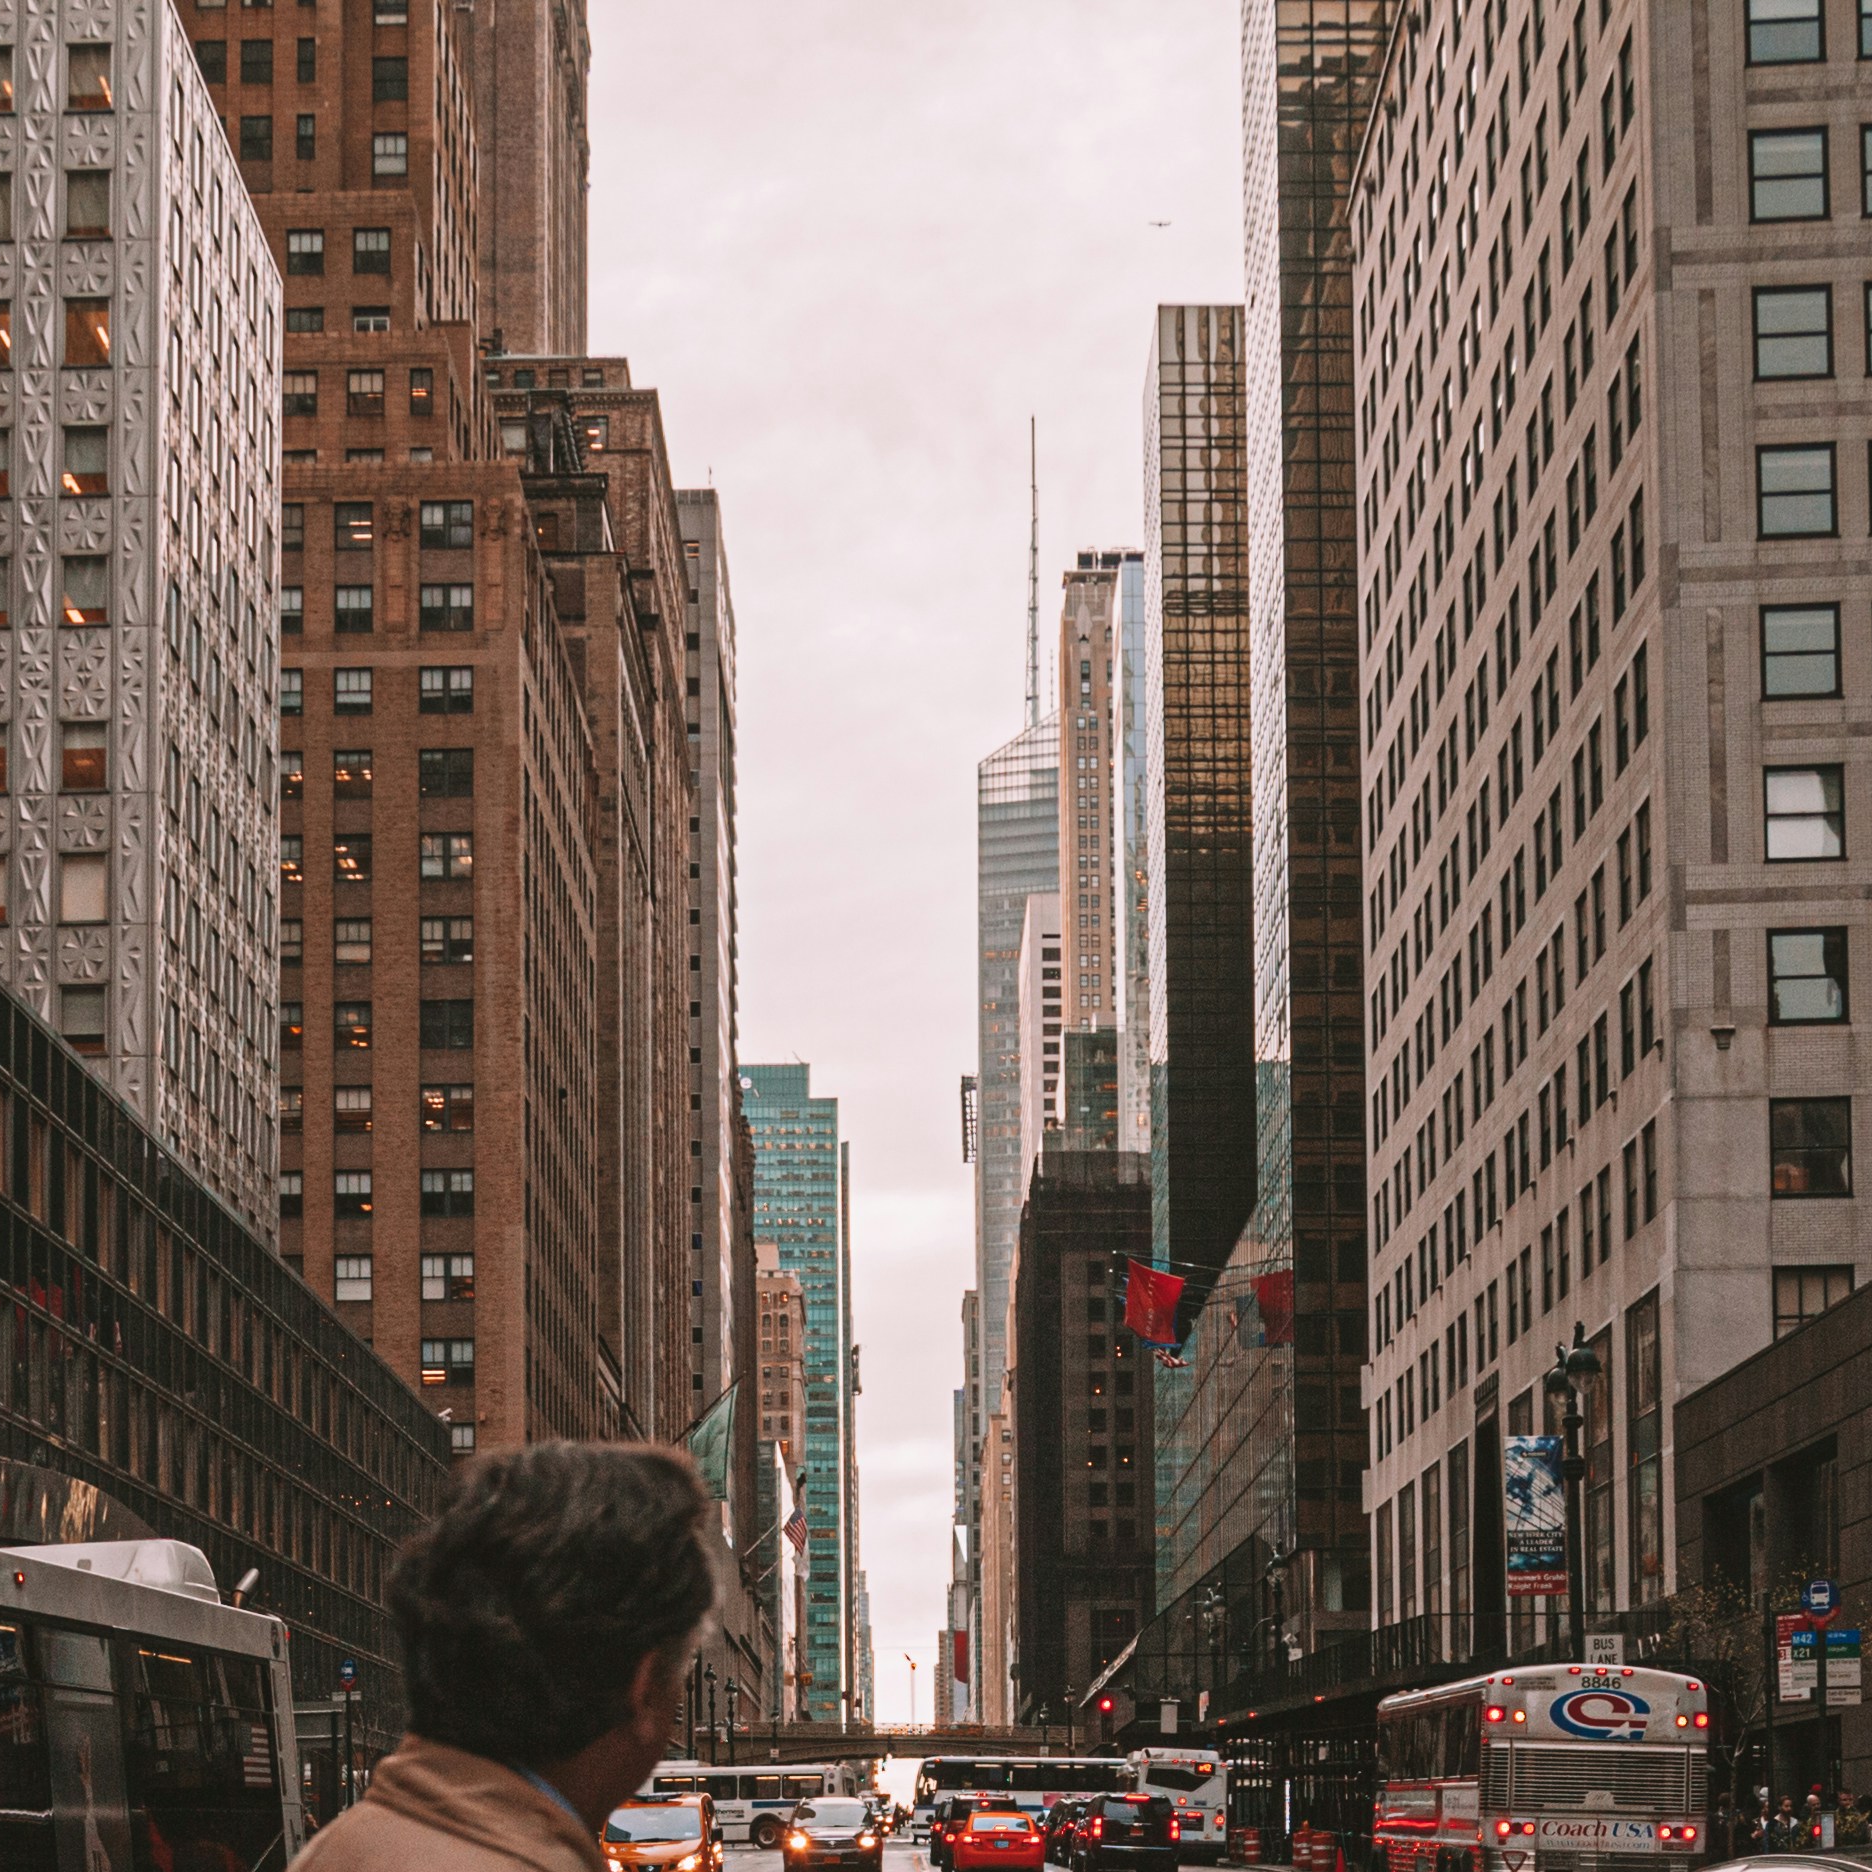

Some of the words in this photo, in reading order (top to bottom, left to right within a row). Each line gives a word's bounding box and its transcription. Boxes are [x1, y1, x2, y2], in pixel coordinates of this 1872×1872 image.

[1593, 1638, 1614, 1650] BUS
[1590, 1653, 1618, 1665] LANE
[1581, 1676, 1622, 1689] 8846
[1542, 1820, 1607, 1837] Coach
[1612, 1821, 1653, 1838] USA
